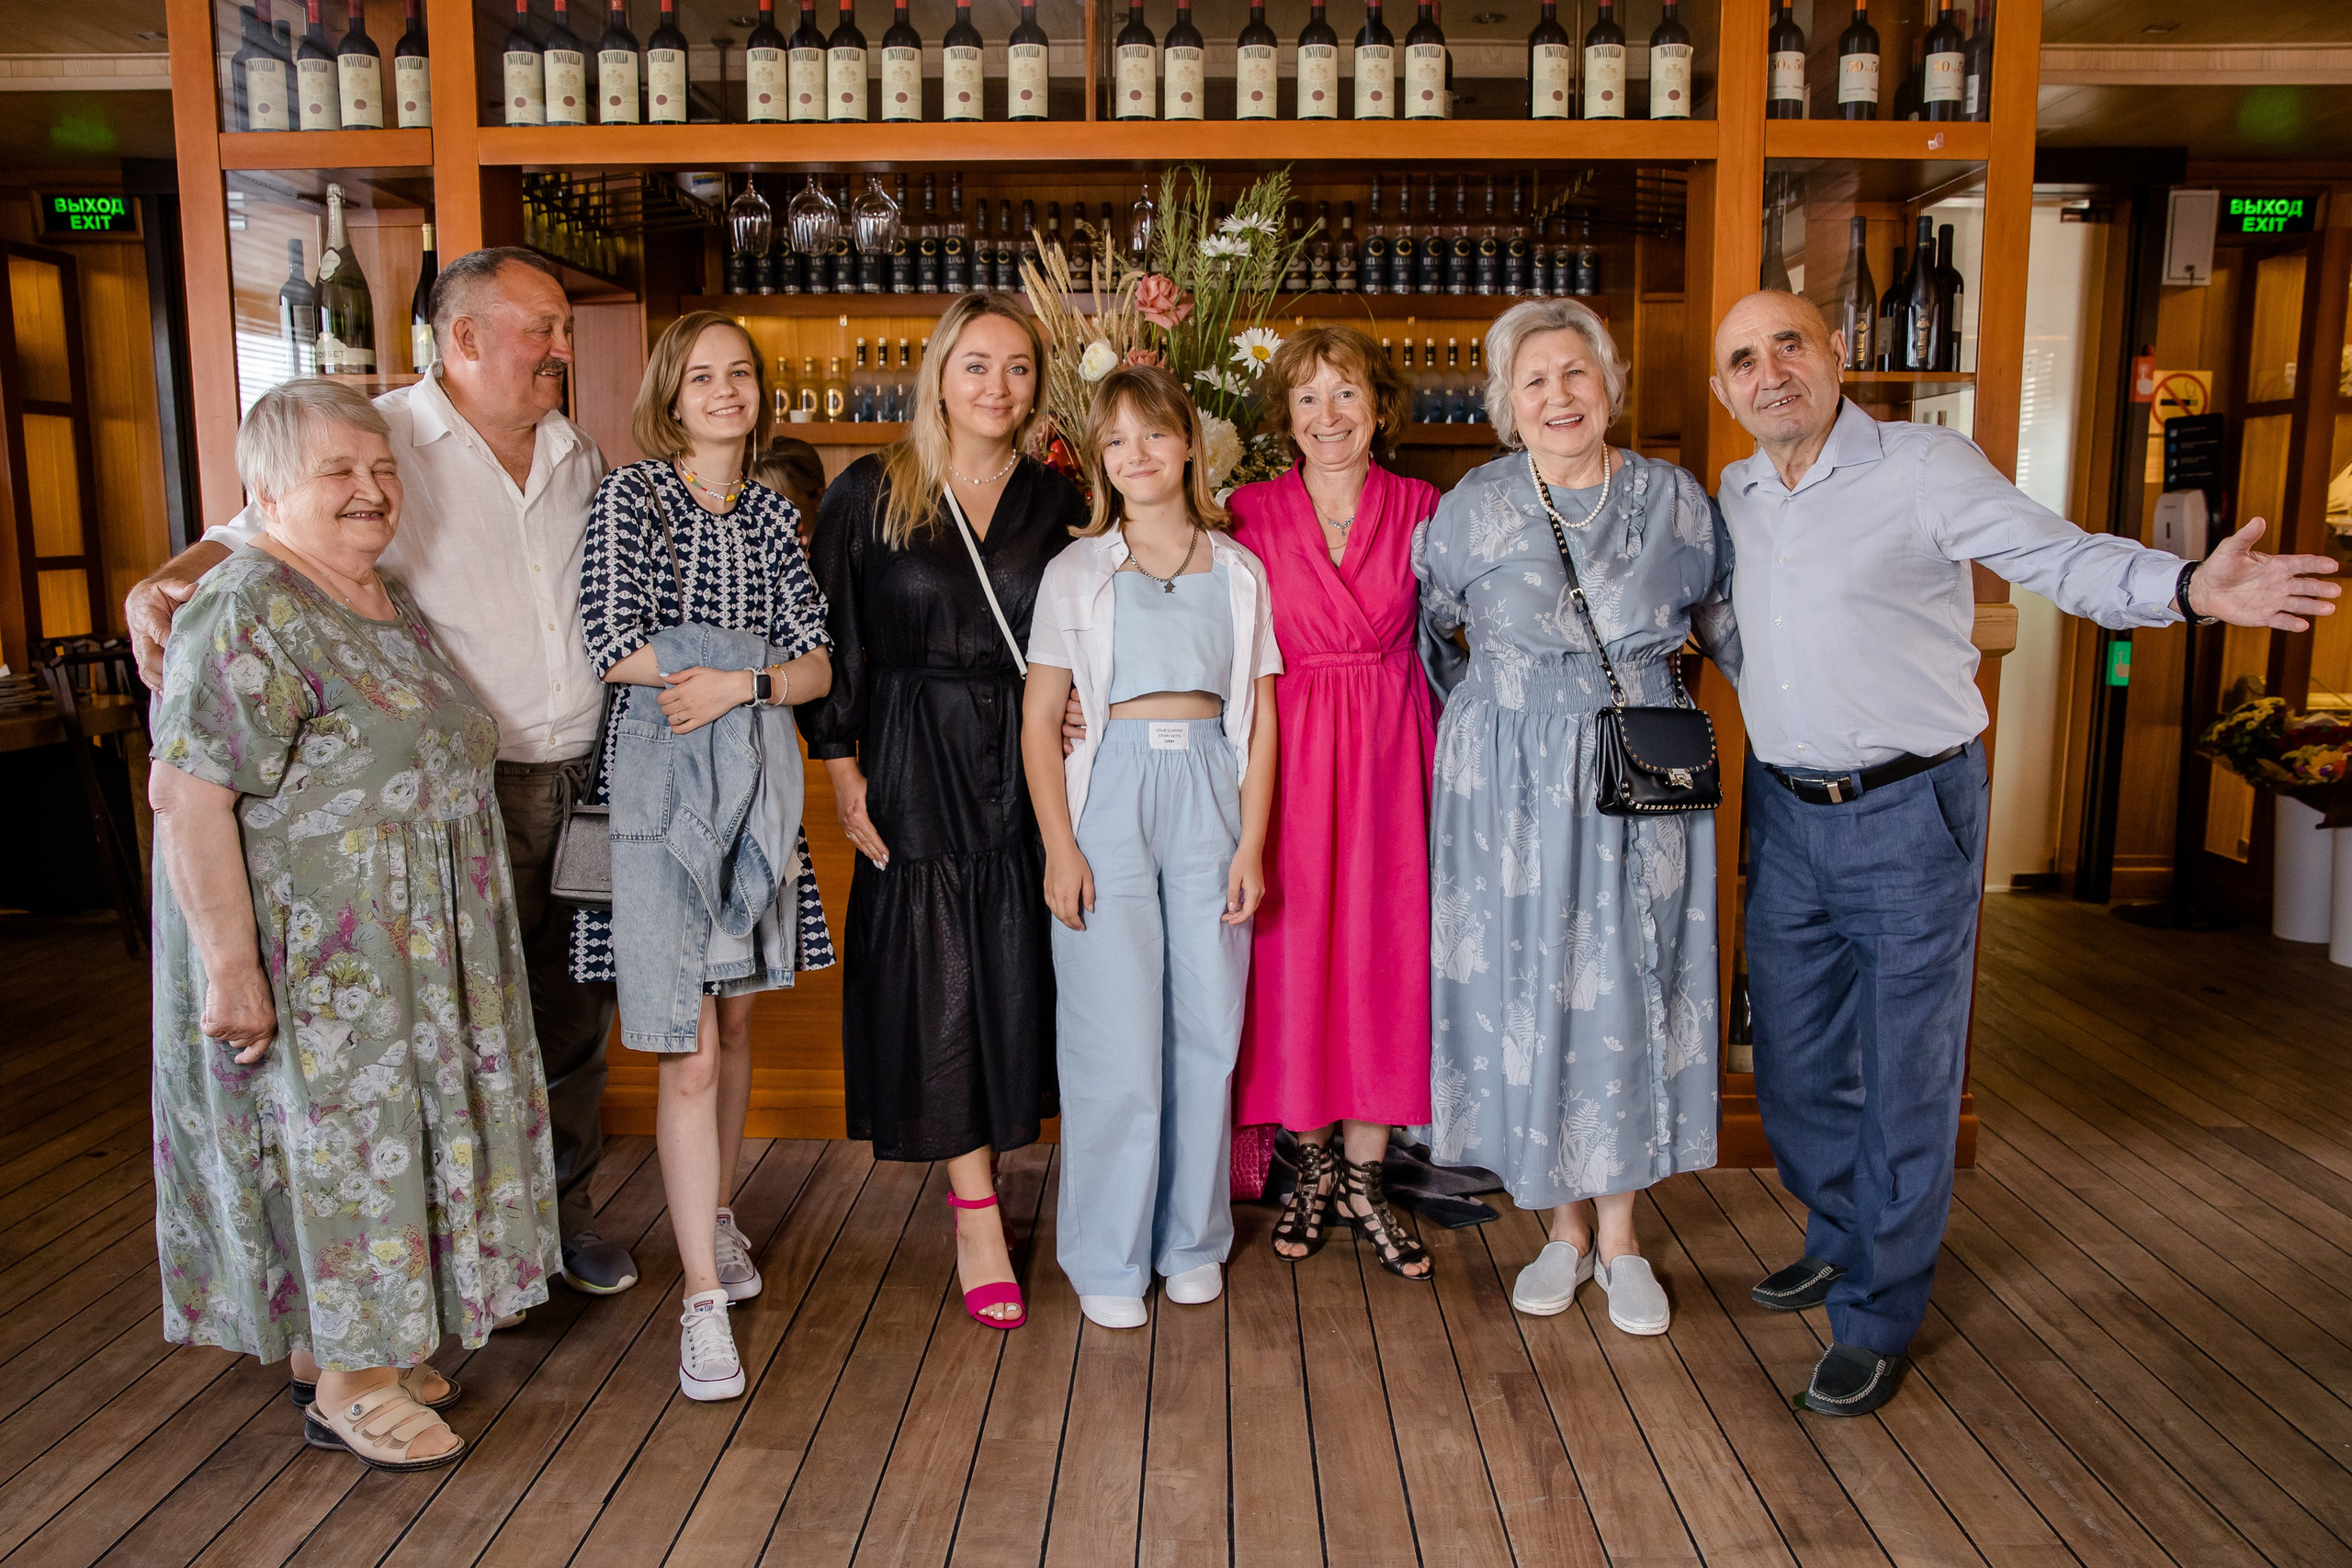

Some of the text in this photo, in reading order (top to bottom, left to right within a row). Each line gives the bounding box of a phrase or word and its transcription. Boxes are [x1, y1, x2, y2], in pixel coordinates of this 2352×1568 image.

[54, 197, 125, 216] ВЫХОД
[2230, 198, 2303, 218] ВЫХОД
[70, 215, 111, 230] EXIT
[2242, 217, 2288, 232] EXIT
